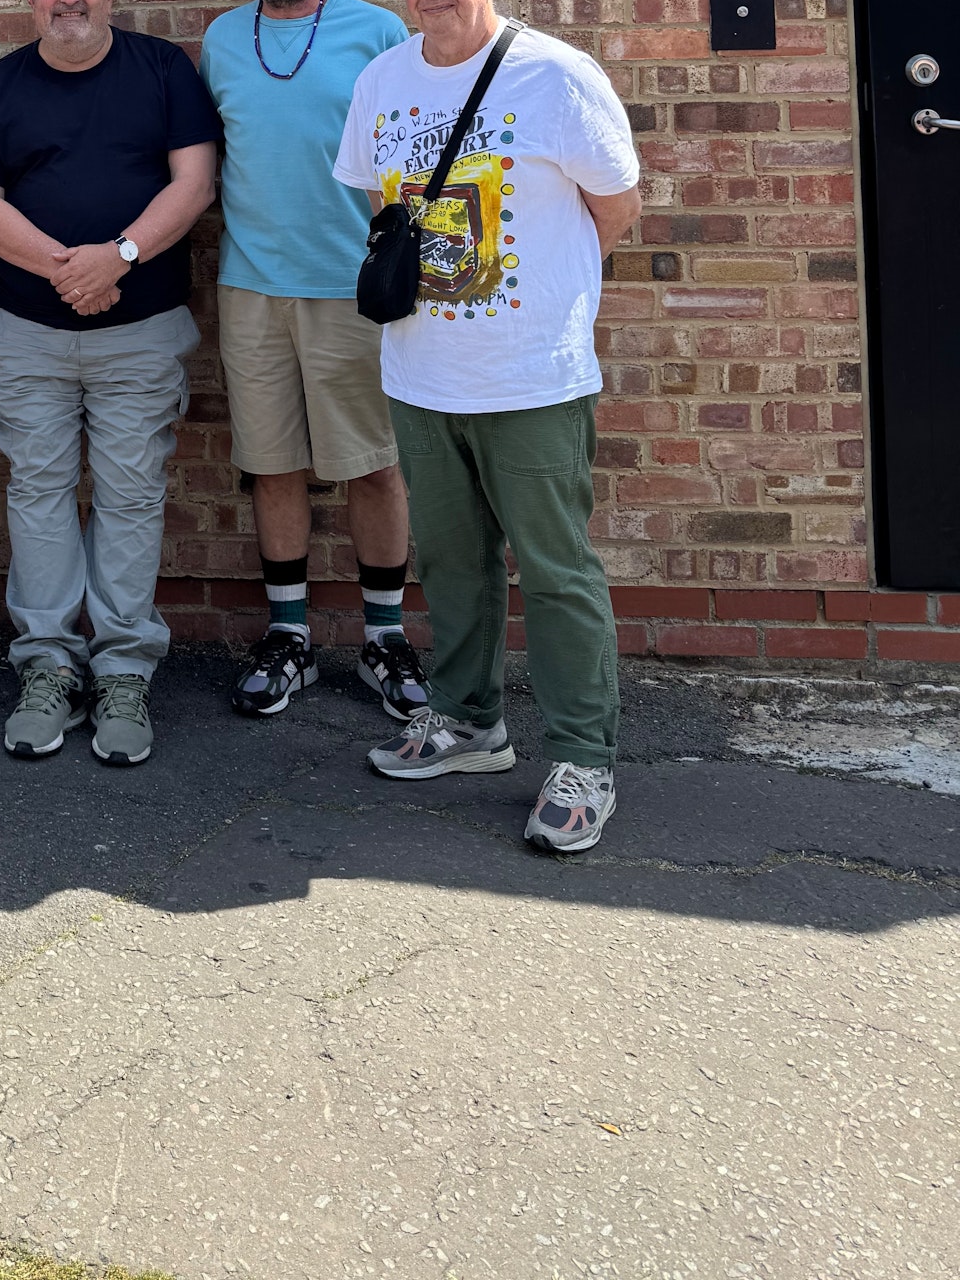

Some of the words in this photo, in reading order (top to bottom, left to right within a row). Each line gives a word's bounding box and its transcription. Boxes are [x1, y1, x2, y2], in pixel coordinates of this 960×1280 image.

[376, 126, 407, 166] 530
[424, 110, 447, 125] 27th
[411, 116, 484, 157] SOUD
[414, 172, 431, 183] NEW
[470, 153, 491, 163] 10001
[449, 225, 470, 234] LONG
[487, 292, 507, 306] PM
[431, 728, 457, 751] N
